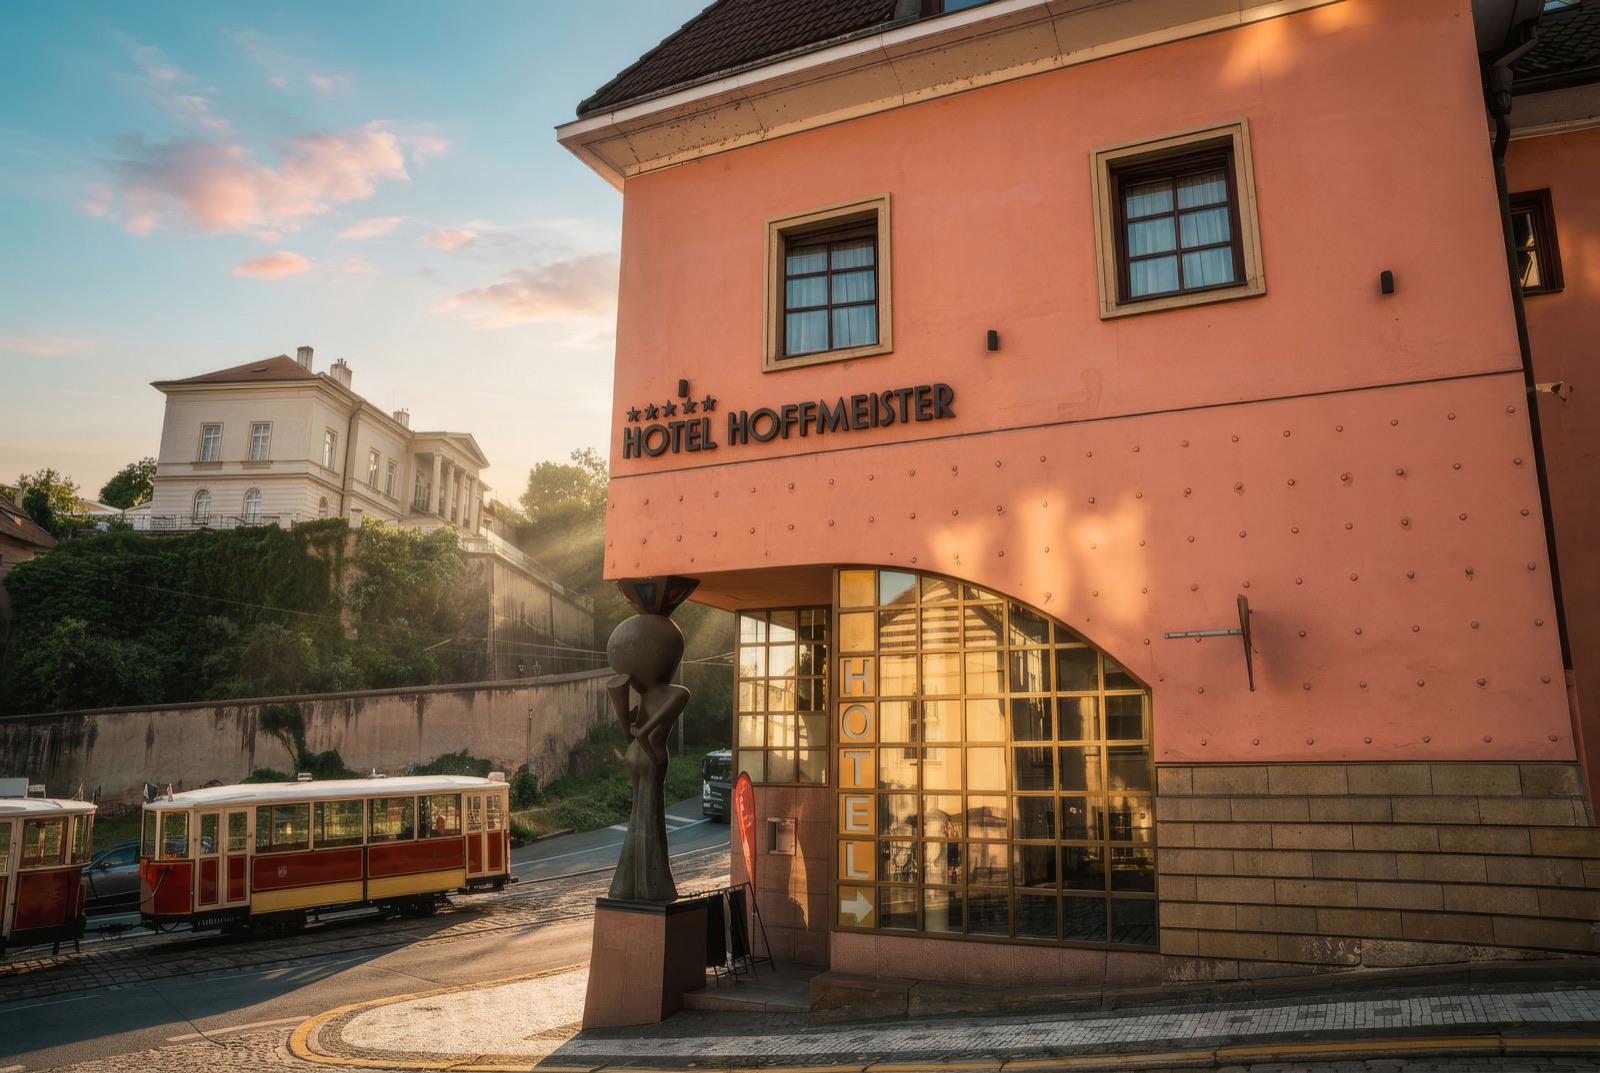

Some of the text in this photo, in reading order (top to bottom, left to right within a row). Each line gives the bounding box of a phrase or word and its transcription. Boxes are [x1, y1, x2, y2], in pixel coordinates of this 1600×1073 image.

[623, 383, 956, 459] HOTEL HOFFMEISTER
[842, 659, 872, 879] HOTEL
